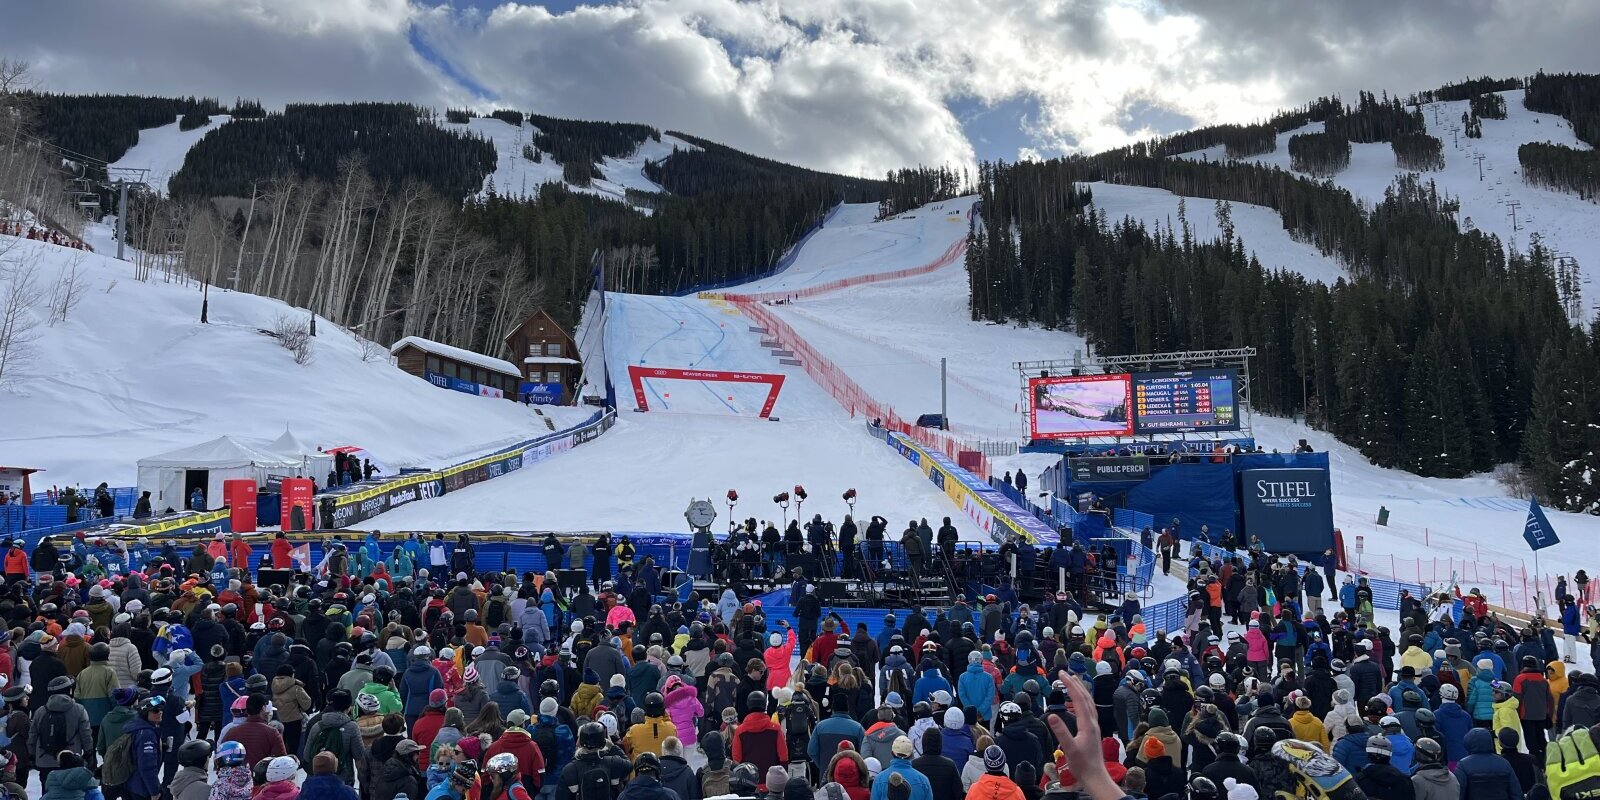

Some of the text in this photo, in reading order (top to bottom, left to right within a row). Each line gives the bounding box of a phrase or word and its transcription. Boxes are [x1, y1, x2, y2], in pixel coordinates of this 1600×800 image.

[430, 373, 448, 388] STIFEL
[529, 394, 554, 404] xfinity
[1257, 480, 1315, 497] STIFEL
